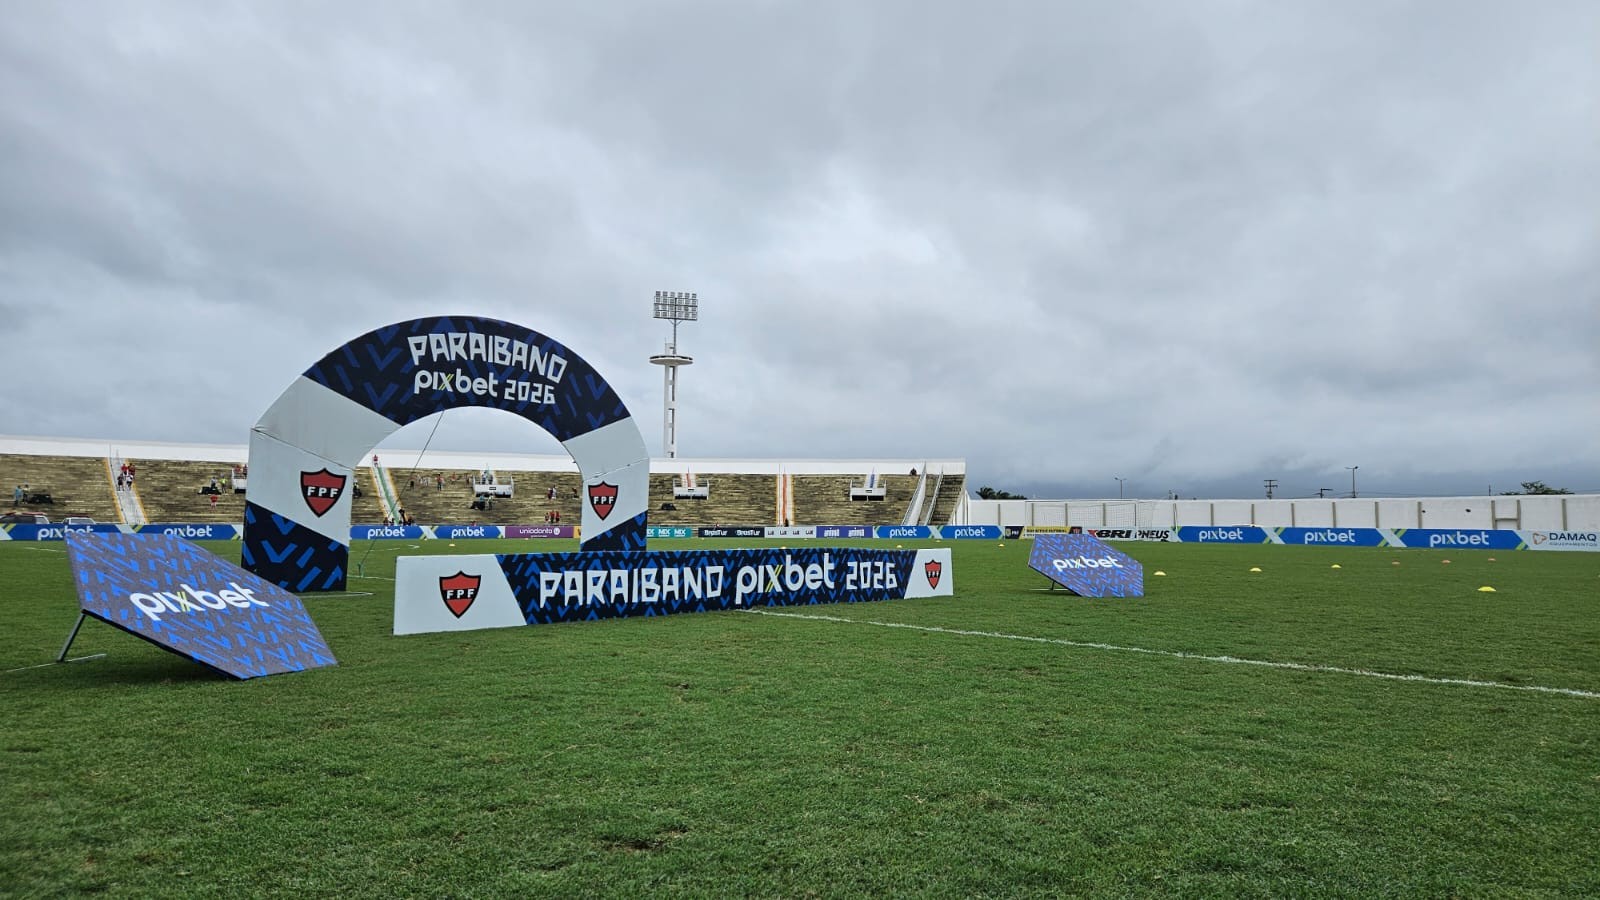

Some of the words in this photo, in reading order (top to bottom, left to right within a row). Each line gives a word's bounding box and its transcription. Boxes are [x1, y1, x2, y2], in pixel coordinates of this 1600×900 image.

[407, 332, 568, 384] PARAIBANO
[414, 368, 498, 397] pixbet
[503, 379, 556, 404] 2026
[367, 526, 405, 540] pixbet
[451, 526, 485, 539] pixbet
[889, 527, 918, 539] pixbet
[954, 527, 986, 539] pixbet
[1135, 530, 1170, 539] PNEUS
[1198, 527, 1244, 542] pixbet
[1304, 529, 1356, 544] pixbet
[1429, 531, 1490, 547] pixbet
[1549, 532, 1597, 542] DAMAQ
[1053, 555, 1124, 572] pixbet
[539, 566, 724, 609] PARAIBANO
[735, 552, 835, 605] pixbet
[846, 561, 898, 590] 2026
[129, 582, 270, 621] pixbet
[446, 588, 475, 600] FPF
